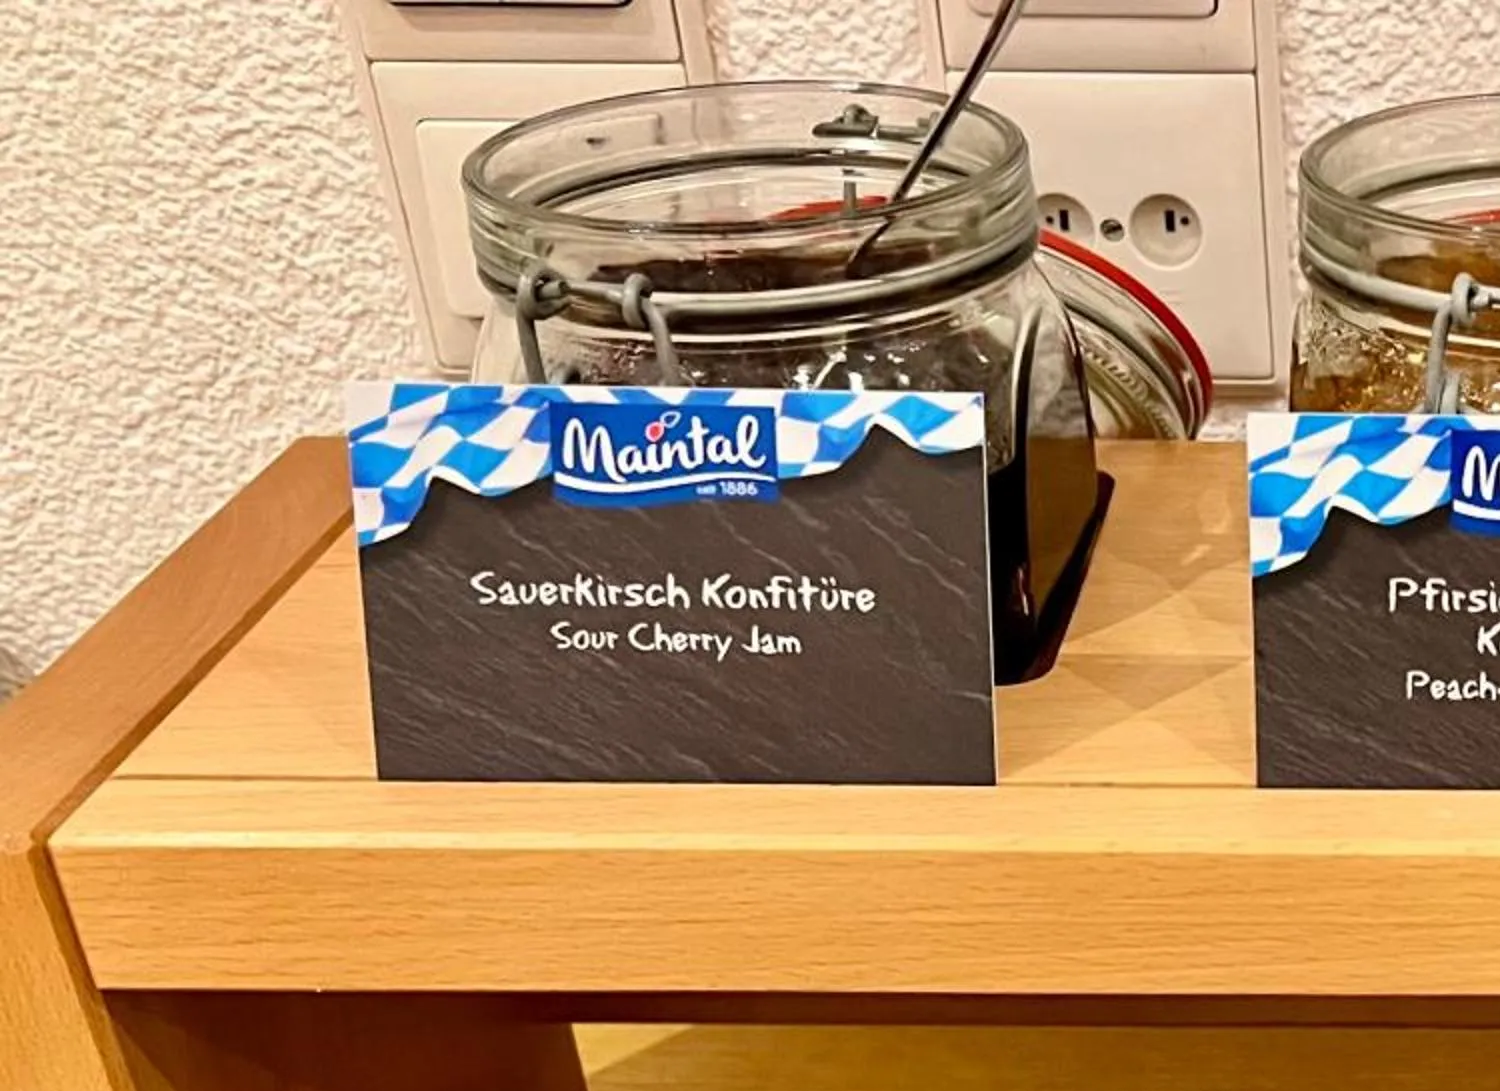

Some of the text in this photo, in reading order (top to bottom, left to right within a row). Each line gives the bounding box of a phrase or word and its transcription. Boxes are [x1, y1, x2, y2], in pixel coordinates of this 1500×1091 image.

[562, 412, 767, 483] Maintal
[719, 481, 758, 496] 1886
[470, 571, 876, 613] Sauerkirsch Konfitüre
[549, 620, 802, 662] Sour Cherry Jam
